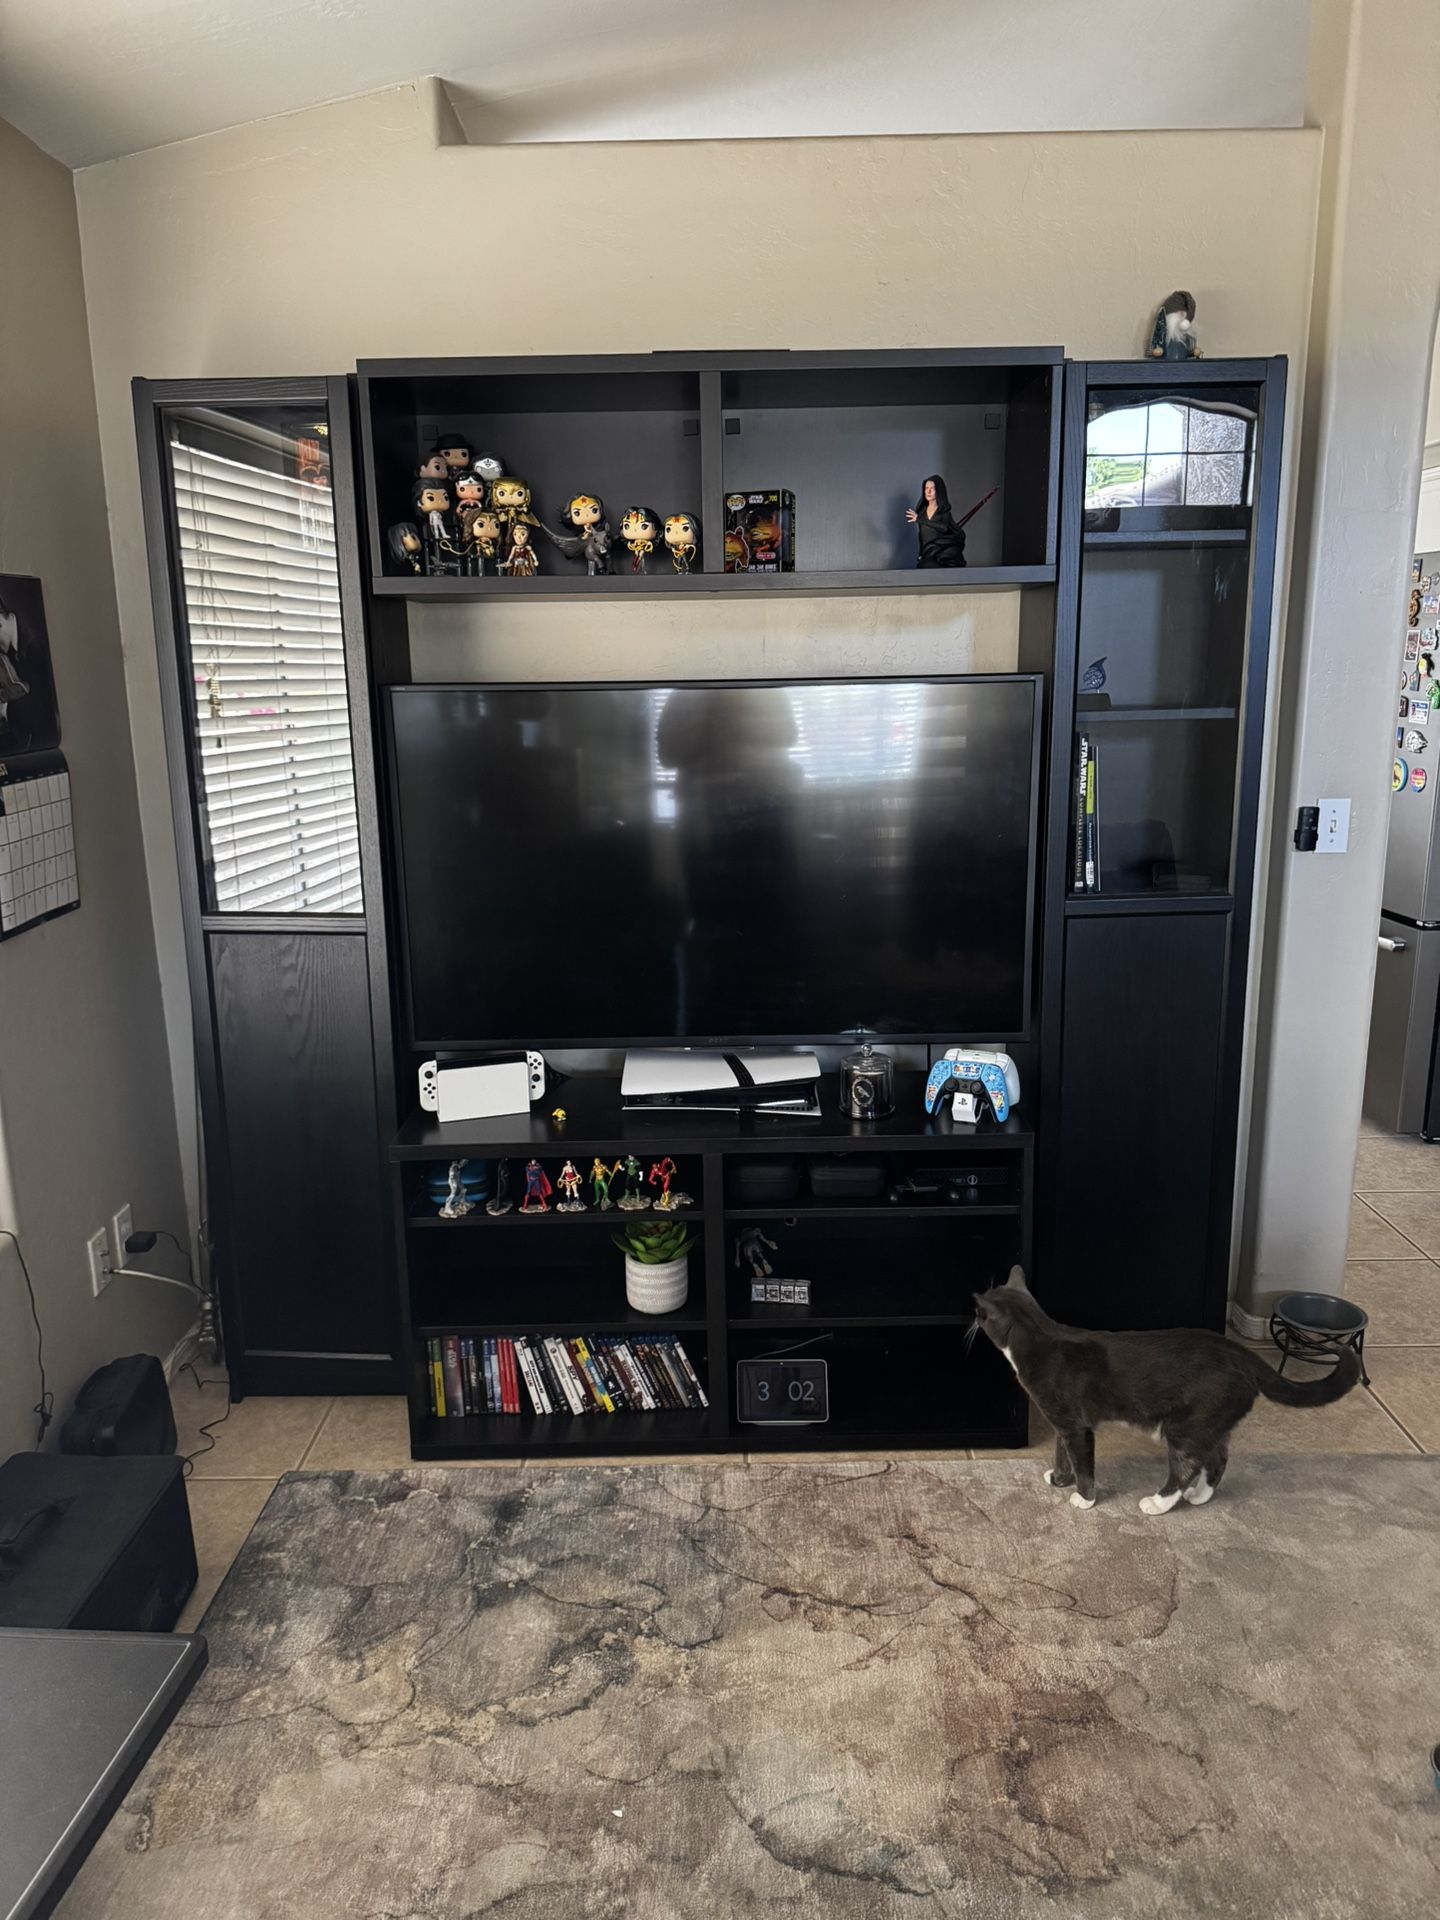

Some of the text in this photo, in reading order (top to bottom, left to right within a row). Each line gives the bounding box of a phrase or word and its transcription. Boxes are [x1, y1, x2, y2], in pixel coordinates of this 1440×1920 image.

[1081, 737, 1089, 767] STAR
[1079, 766, 1088, 796] WARS
[758, 1381, 770, 1401] 3
